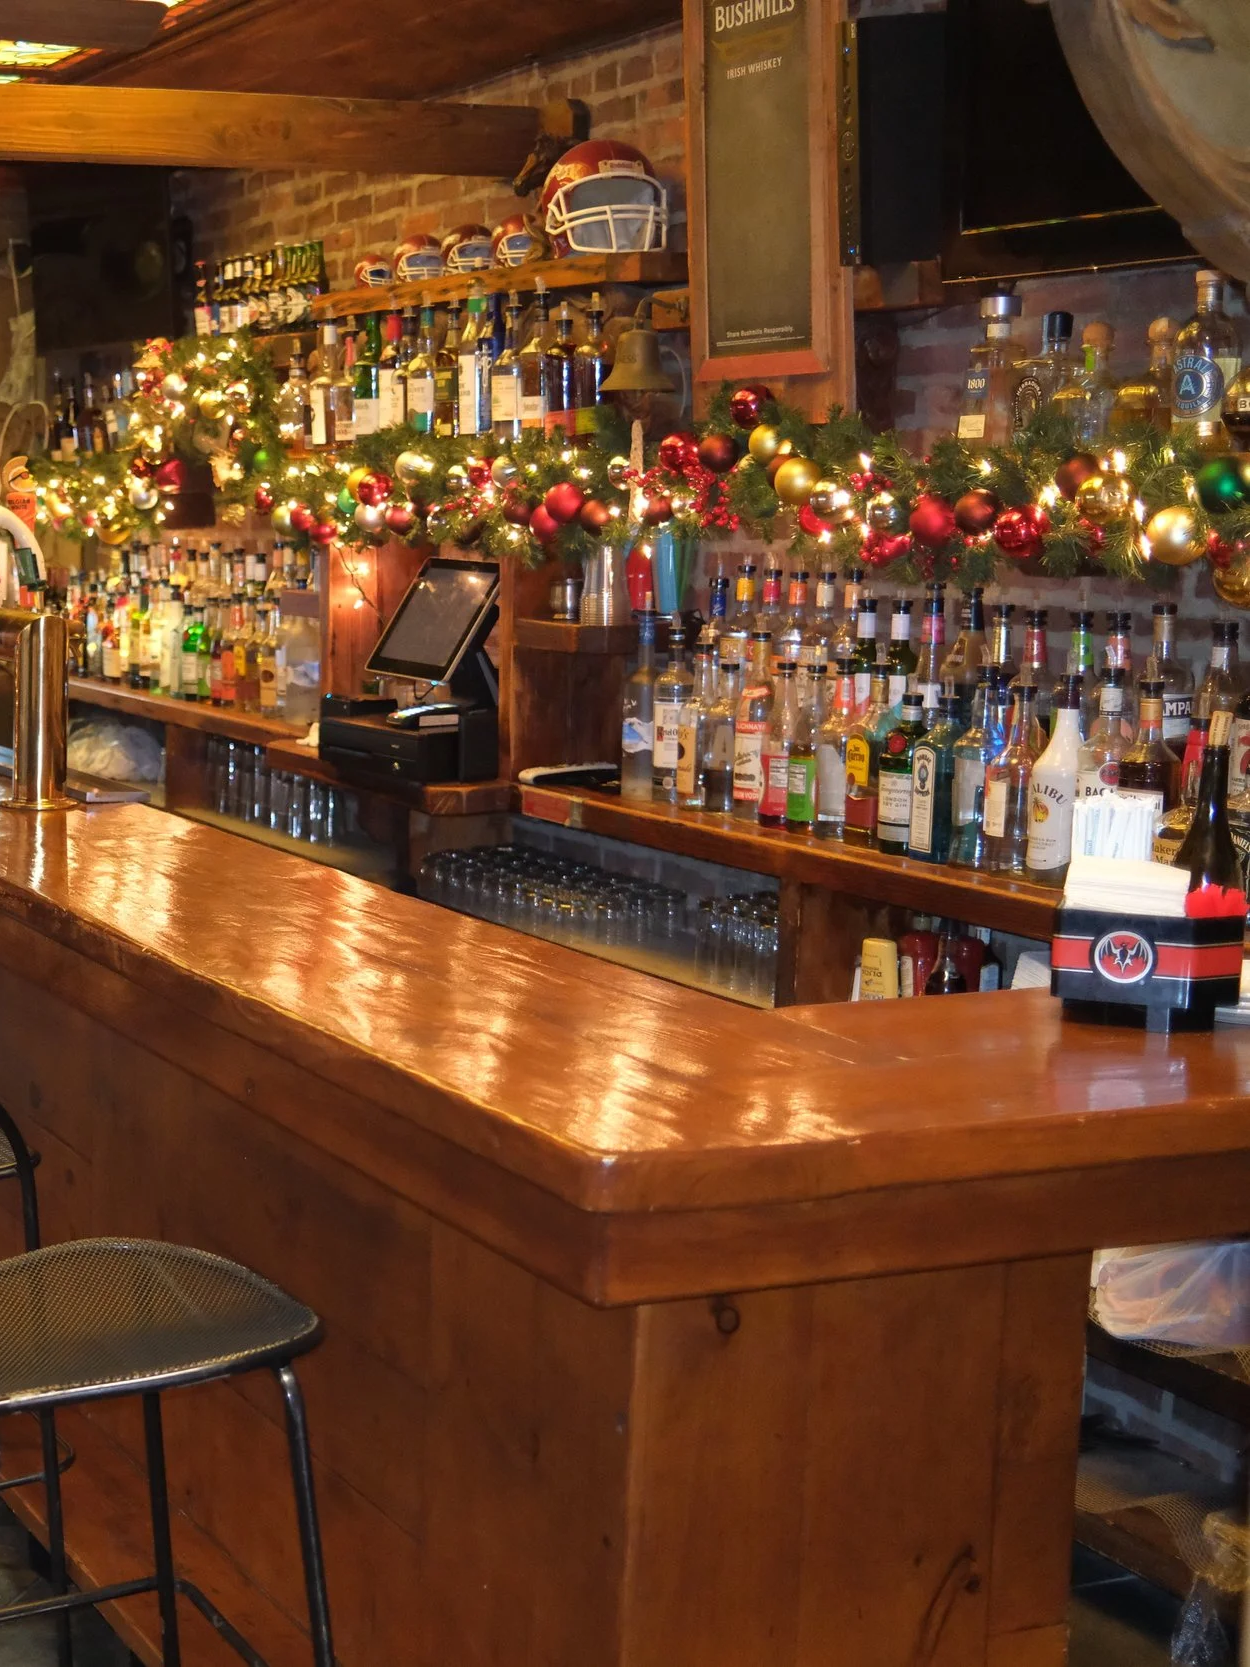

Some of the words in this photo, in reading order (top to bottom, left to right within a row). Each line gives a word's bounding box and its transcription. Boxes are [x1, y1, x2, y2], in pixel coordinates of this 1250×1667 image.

[714, 0, 795, 33] BUSHMILLS
[726, 65, 746, 80] IRISH
[747, 56, 782, 75] WHISKEY
[967, 378, 986, 389] 1800
[1032, 783, 1068, 805] ALIBU
